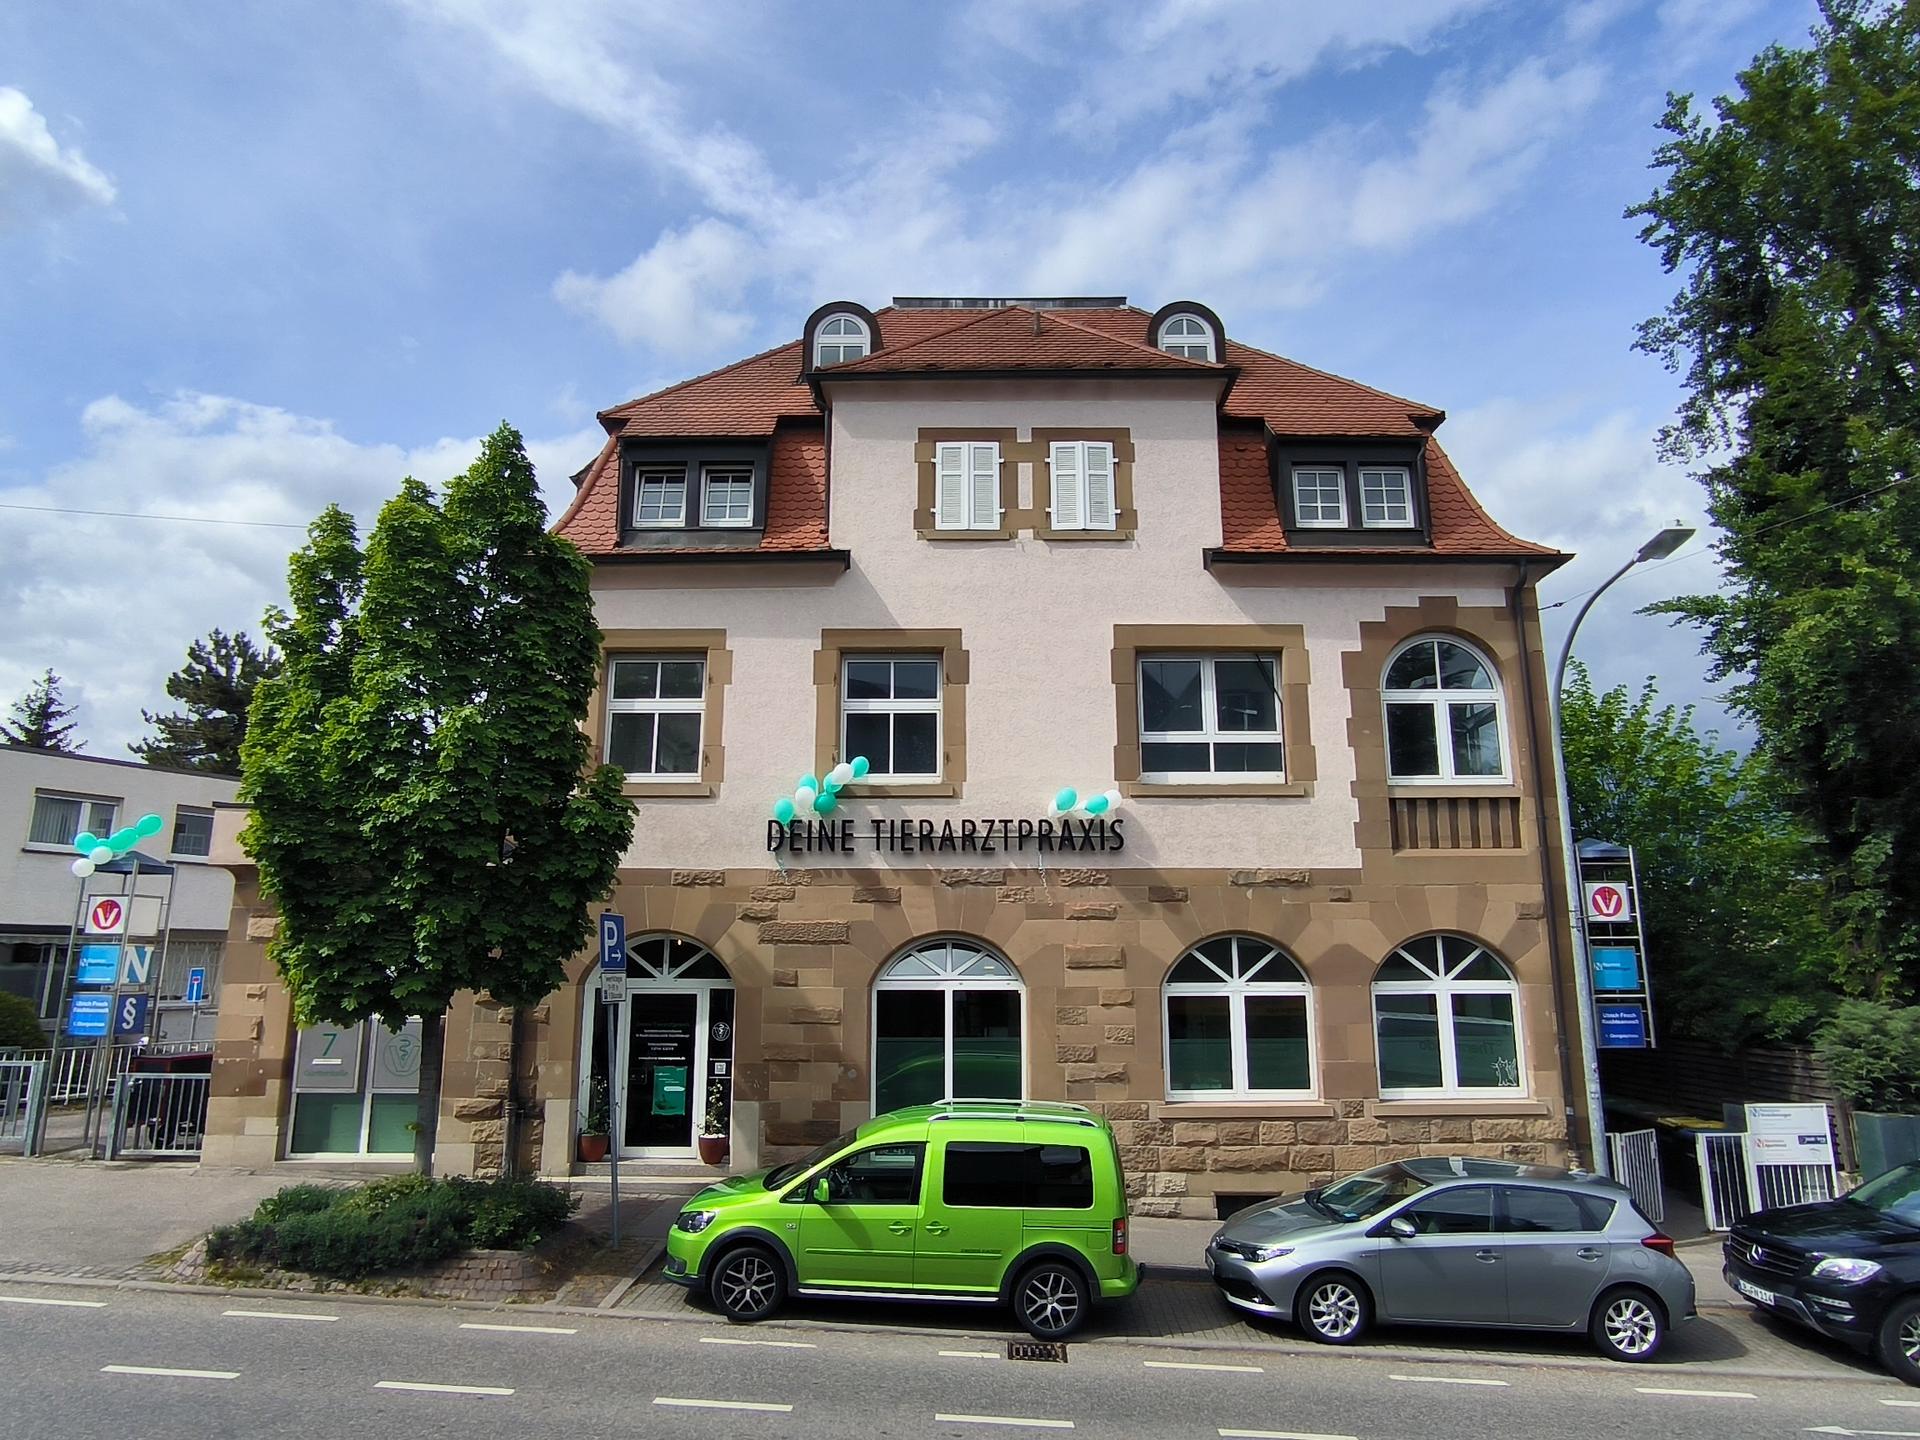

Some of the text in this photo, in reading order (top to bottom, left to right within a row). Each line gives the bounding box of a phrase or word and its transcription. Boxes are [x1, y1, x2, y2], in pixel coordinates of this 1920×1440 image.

[767, 819, 1125, 852] DEINE TIERARZTPRAXIS
[604, 920, 618, 962] P
[322, 1033, 338, 1057] 7
